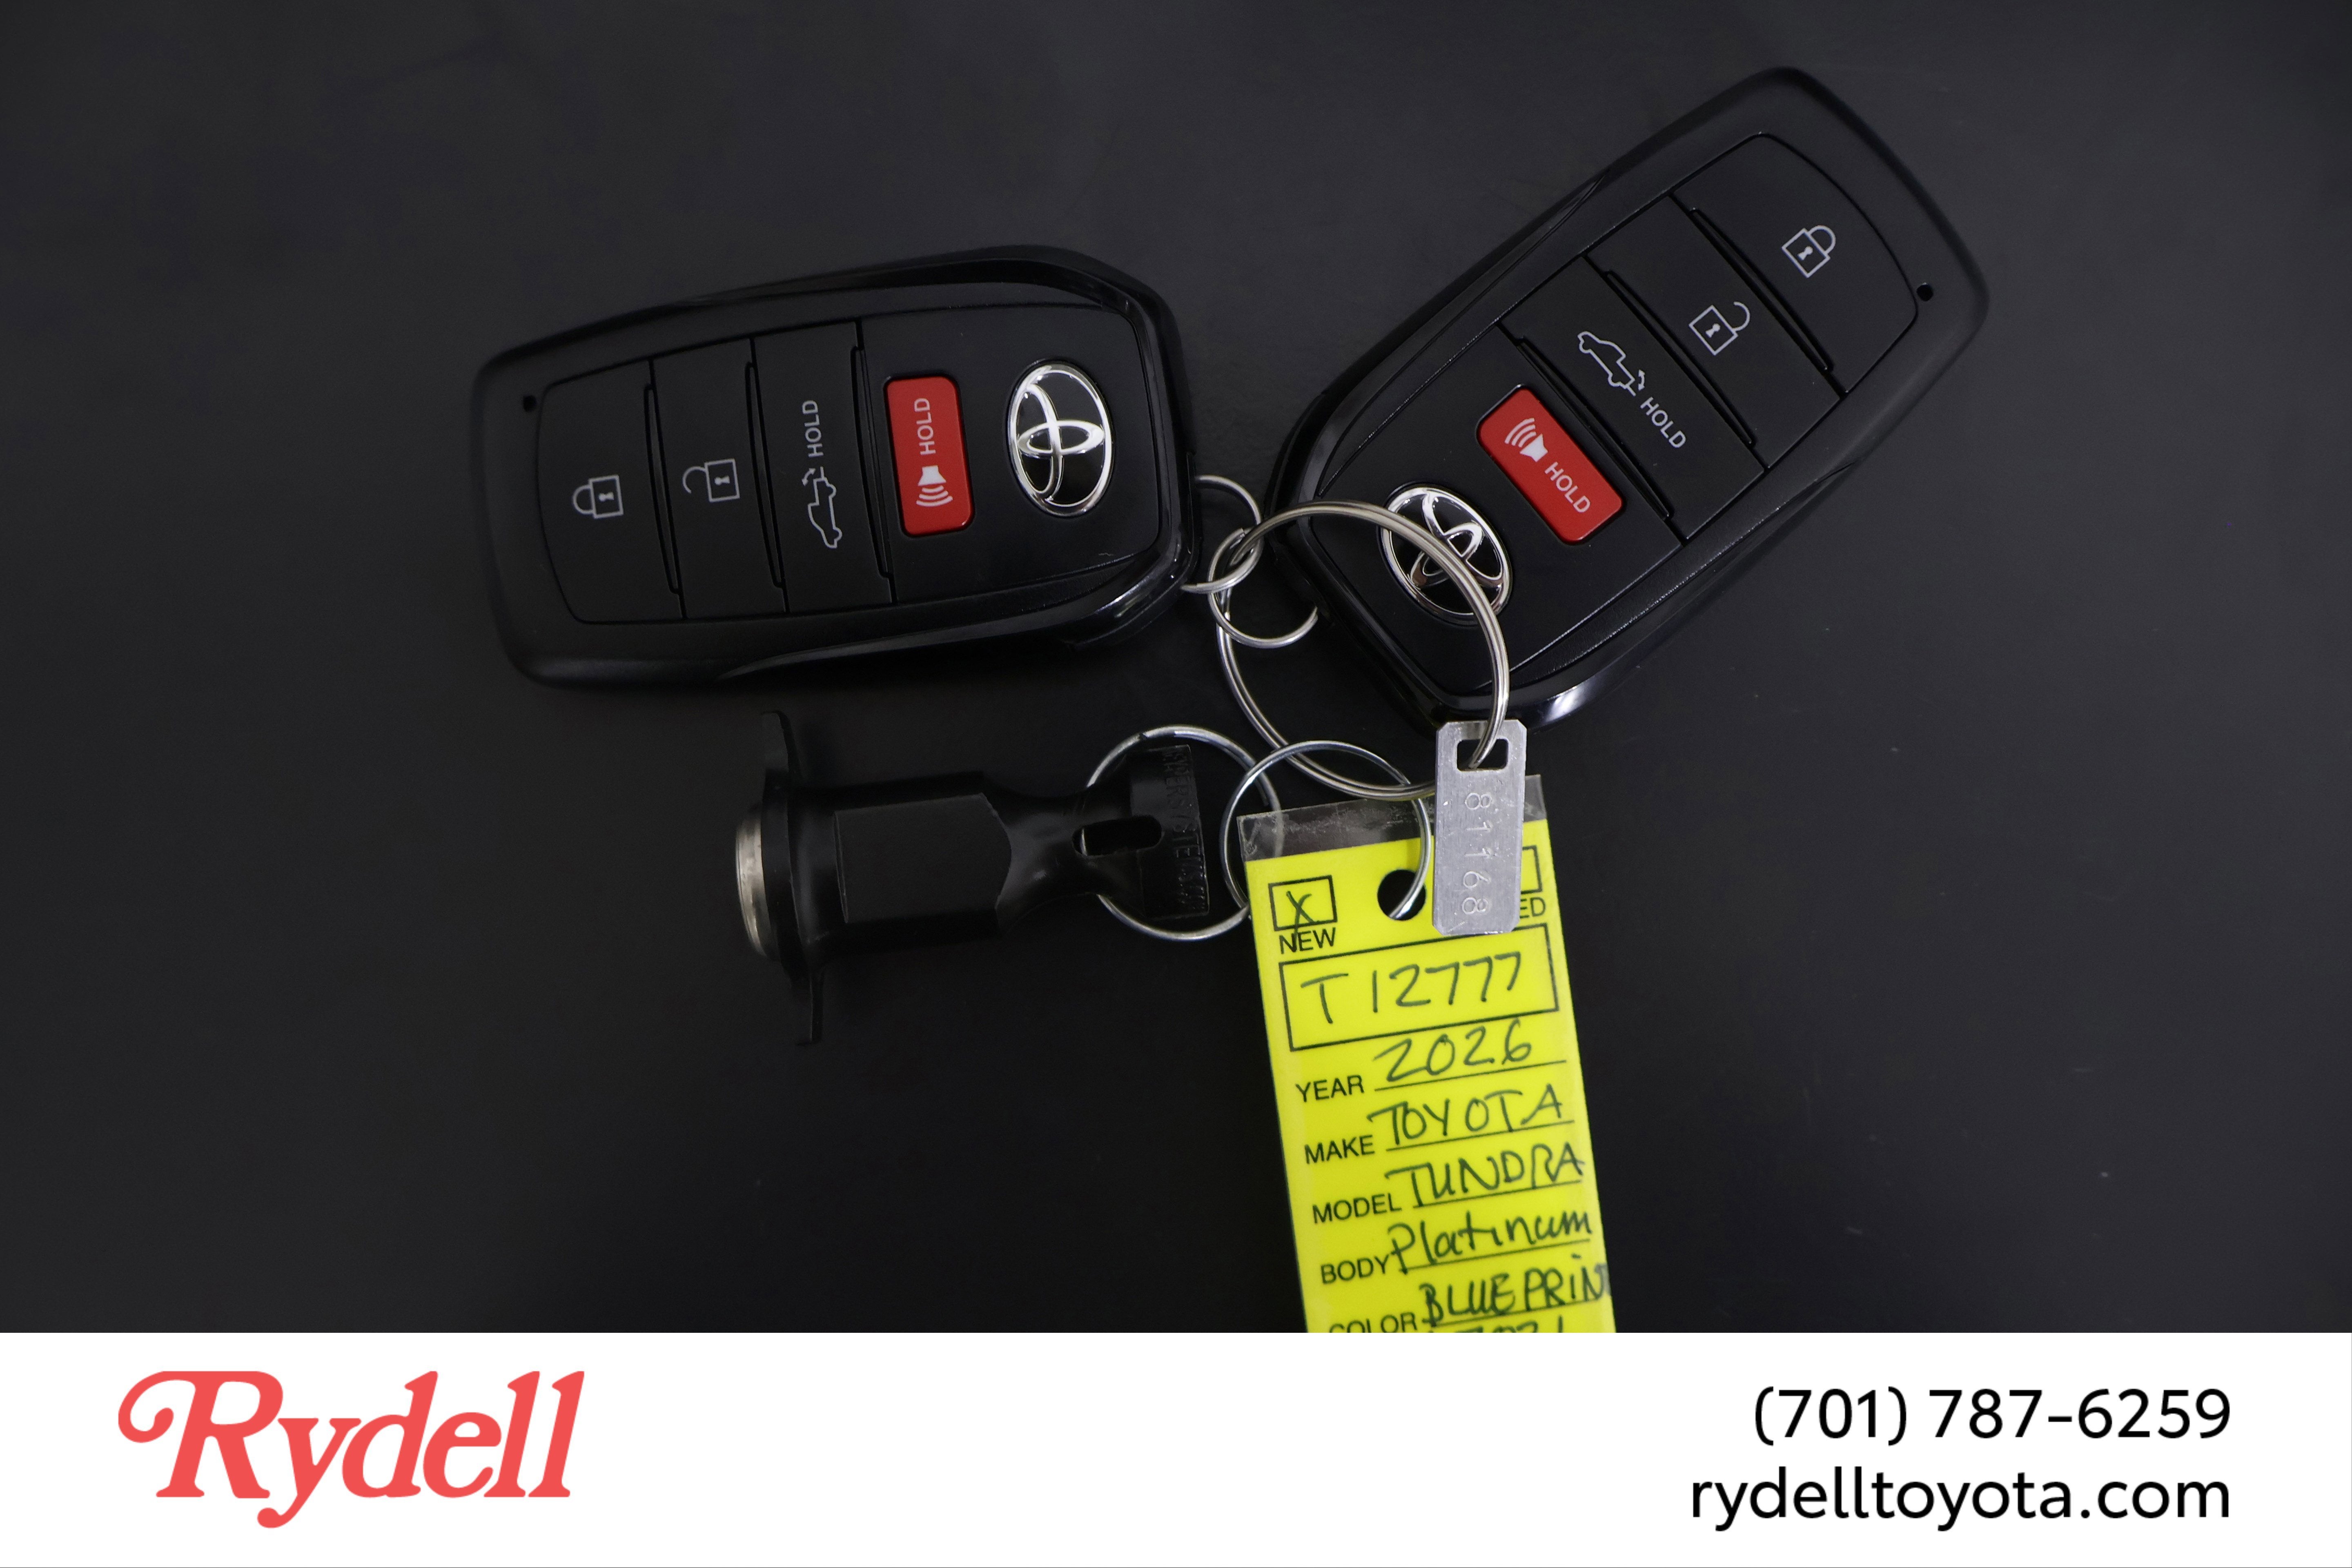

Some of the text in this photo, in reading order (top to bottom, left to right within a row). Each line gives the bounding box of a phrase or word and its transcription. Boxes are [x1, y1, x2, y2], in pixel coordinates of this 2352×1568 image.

[802, 400, 824, 457] HOLD
[914, 398, 936, 455] HOLD
[1640, 397, 1686, 448] HOLD
[1544, 462, 1590, 513] HOLD
[1461, 792, 1492, 915] 81168
[1279, 928, 1335, 954] NEW
[1374, 1018, 1532, 1082] 2026
[1295, 1075, 1364, 1103] YEAR
[1367, 1084, 1562, 1145] TOYOTA
[1305, 1135, 1375, 1164] MAKE
[1384, 1142, 1585, 1207] TUNDRA
[1312, 1194, 1401, 1224] MODEL
[1321, 1255, 1390, 1284] BODY
[1388, 1212, 1592, 1275] Platinum
